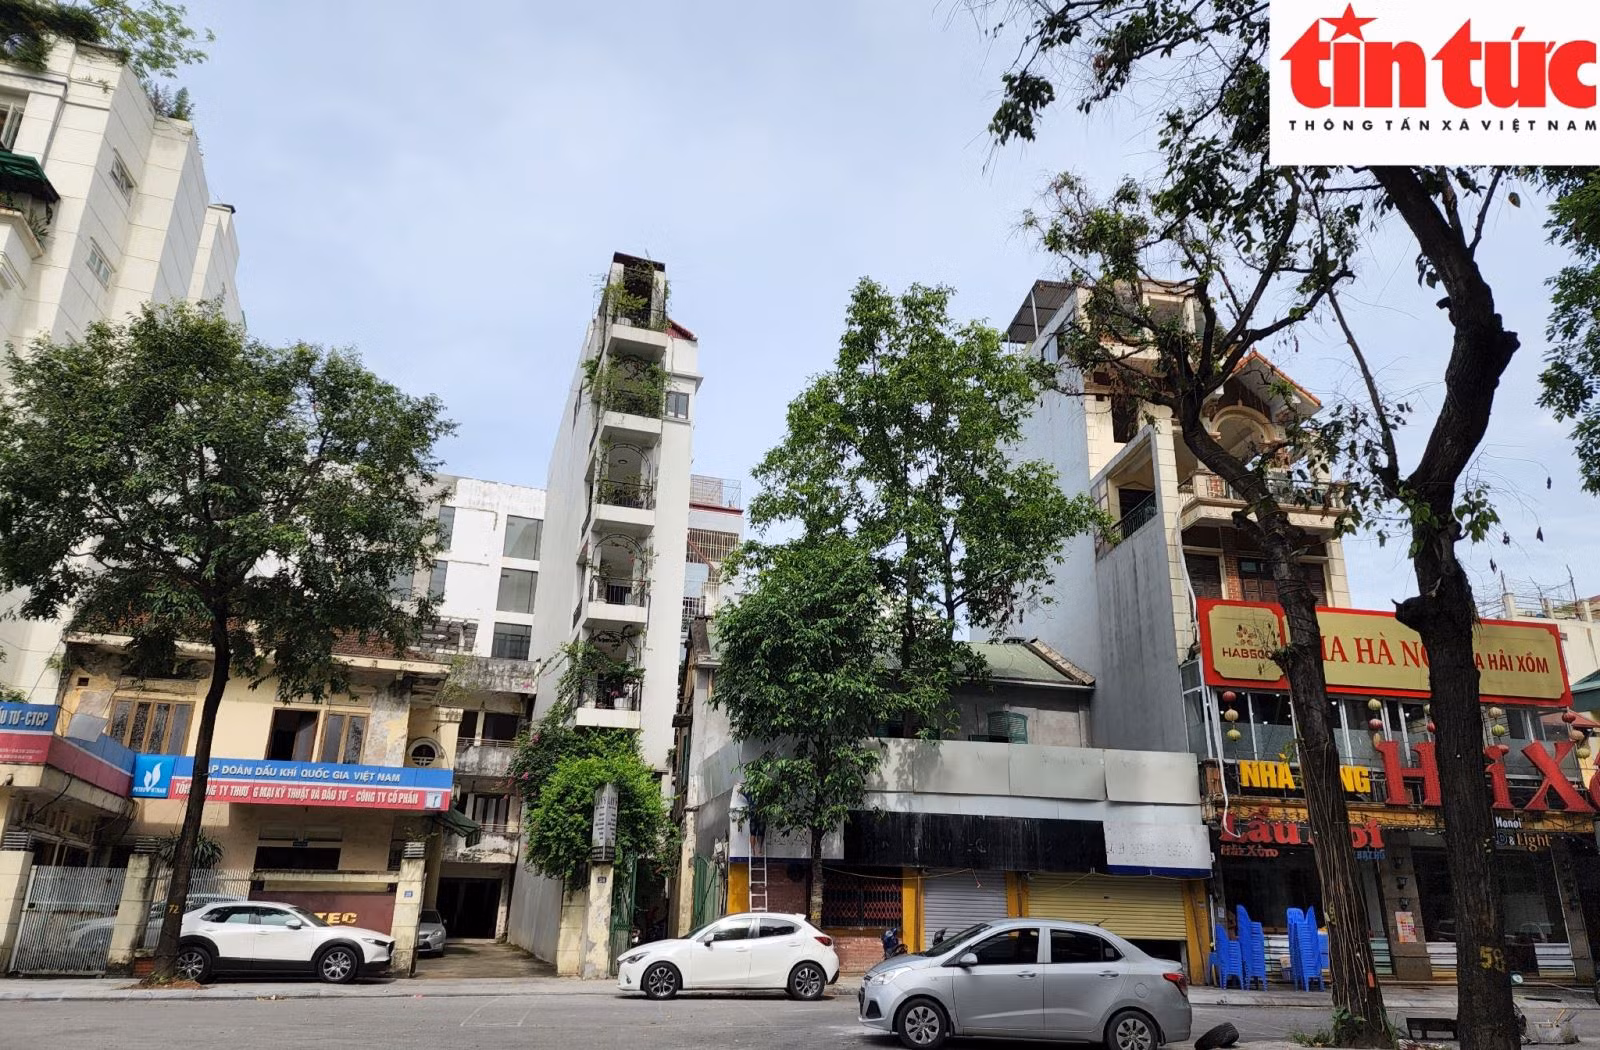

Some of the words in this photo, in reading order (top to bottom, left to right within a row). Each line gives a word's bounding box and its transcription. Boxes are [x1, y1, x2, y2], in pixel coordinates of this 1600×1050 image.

[1320, 634, 1349, 663] IA
[1354, 632, 1396, 666] HÀ
[1488, 649, 1514, 671] HẢI
[221, 764, 253, 776] ĐOÀN
[300, 767, 330, 779] QUỐC
[332, 770, 350, 780] GIA
[353, 771, 376, 782] VIỆT
[377, 772, 401, 782] NAM
[1239, 753, 1296, 789] NHÀ
[1340, 765, 1371, 793] NG
[218, 785, 229, 796] TY
[1494, 816, 1522, 829] Hanoi
[1516, 832, 1550, 852] Light
[313, 912, 358, 924] TEC
